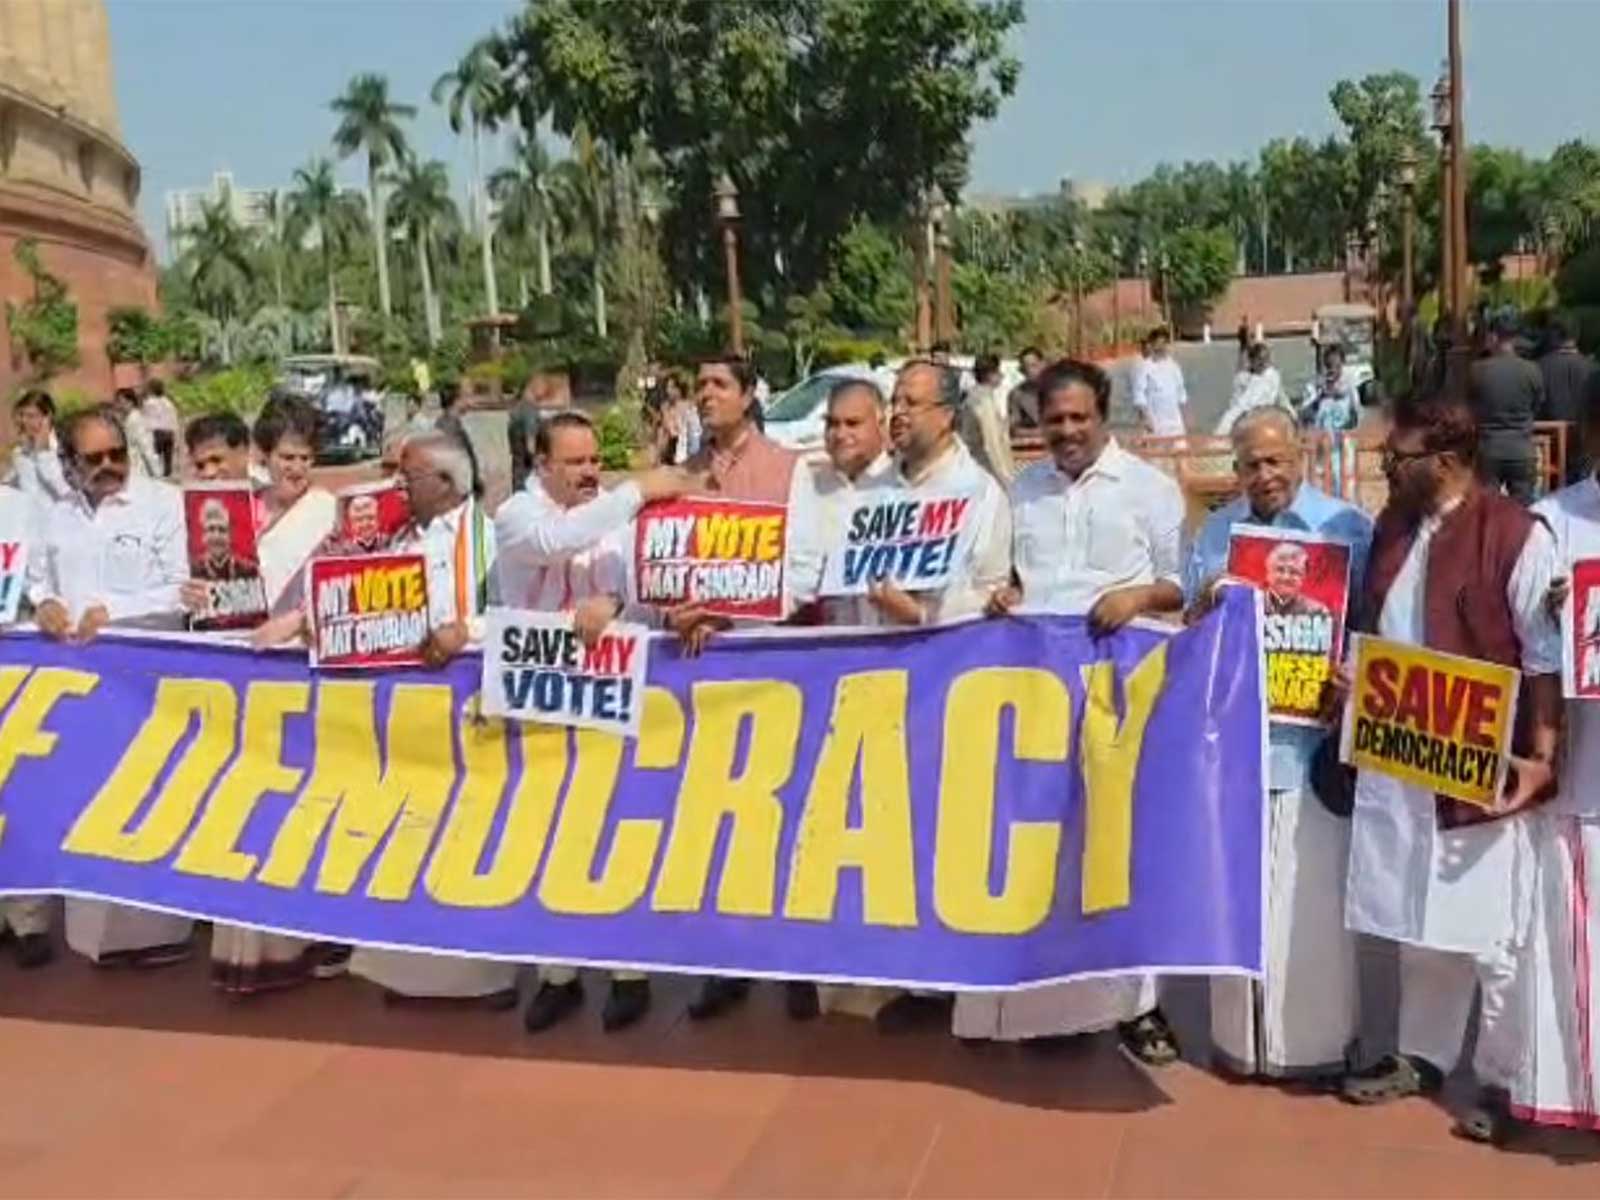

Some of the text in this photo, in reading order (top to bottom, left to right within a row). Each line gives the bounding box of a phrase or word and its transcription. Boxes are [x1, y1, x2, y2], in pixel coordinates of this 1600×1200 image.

[643, 512, 785, 561] MY VOTE
[848, 498, 969, 542] SAVE MY
[640, 564, 690, 600] MAT
[843, 533, 958, 586] VOTE!
[353, 561, 425, 614] VOTE
[501, 626, 637, 673] SAVE MY
[502, 669, 633, 723] VOTE!
[1363, 656, 1502, 749] SAVE
[1355, 716, 1499, 790] DEMOCRACY!
[61, 641, 1168, 935] DEMOCRACY
